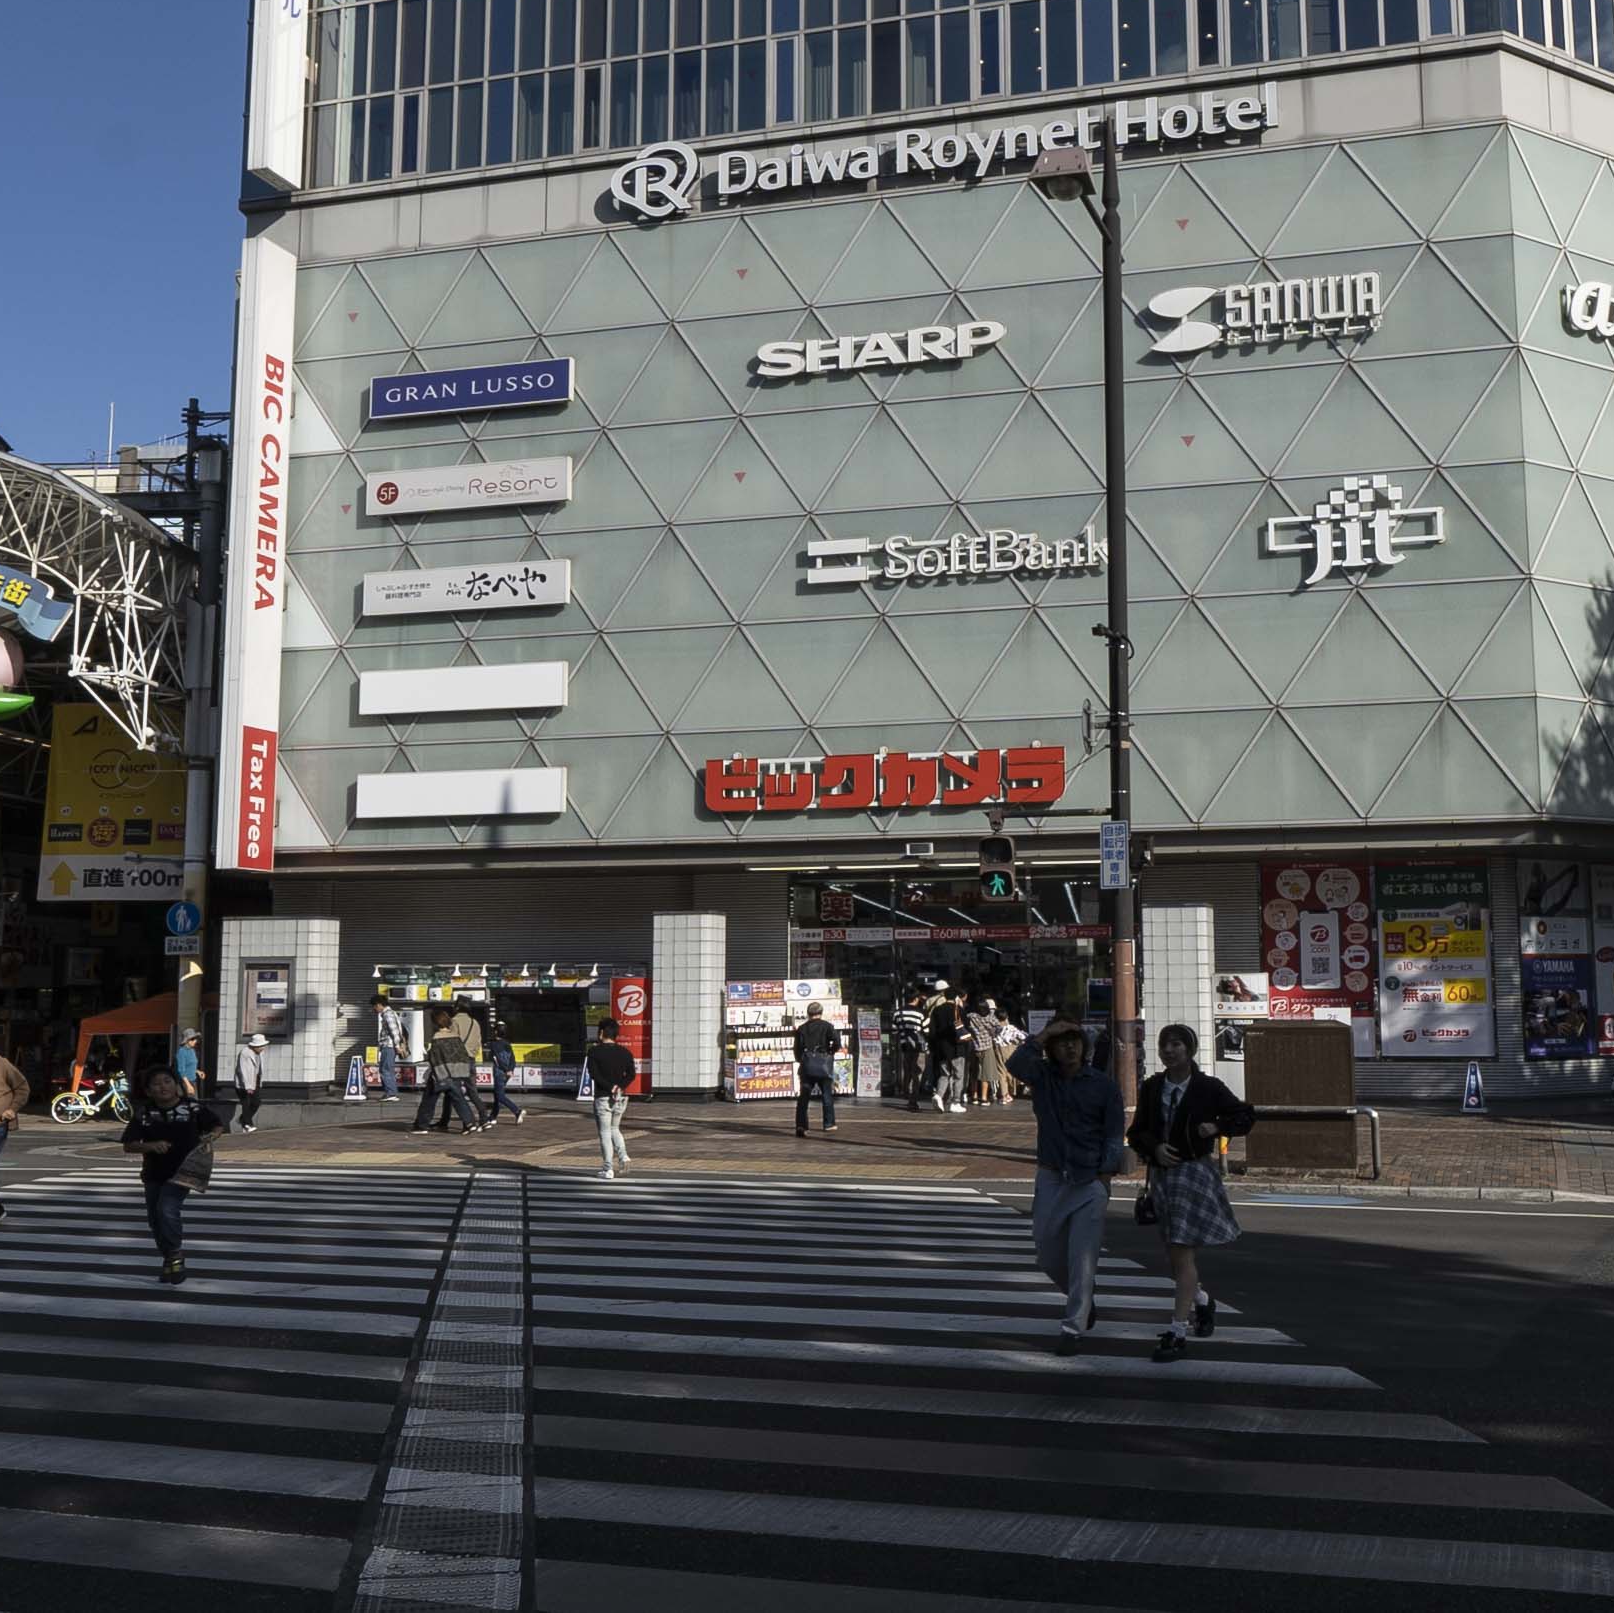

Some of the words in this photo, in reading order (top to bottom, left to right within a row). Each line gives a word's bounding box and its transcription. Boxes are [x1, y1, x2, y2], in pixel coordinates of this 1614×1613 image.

[718, 143, 878, 195] Daiwa
[895, 108, 1101, 177] Roynet
[1114, 81, 1280, 146] Hotel
[1225, 272, 1381, 327] SANWA
[756, 320, 1009, 377] SHARP
[262, 354, 285, 424] BIC
[385, 383, 457, 403] GRAN
[471, 373, 555, 395] LUSSO
[378, 486, 397, 501] 5F
[468, 476, 558, 495] Resort
[253, 433, 283, 610] CAMERA
[884, 524, 1108, 581] SoftBank
[465, 566, 547, 601] なべや
[248, 739, 268, 792] Tax
[706, 746, 1065, 811] ビックカメラ
[245, 795, 267, 860] Free
[1542, 960, 1575, 973] YAMAHA
[1421, 1028, 1470, 1037] ビックカメラ
